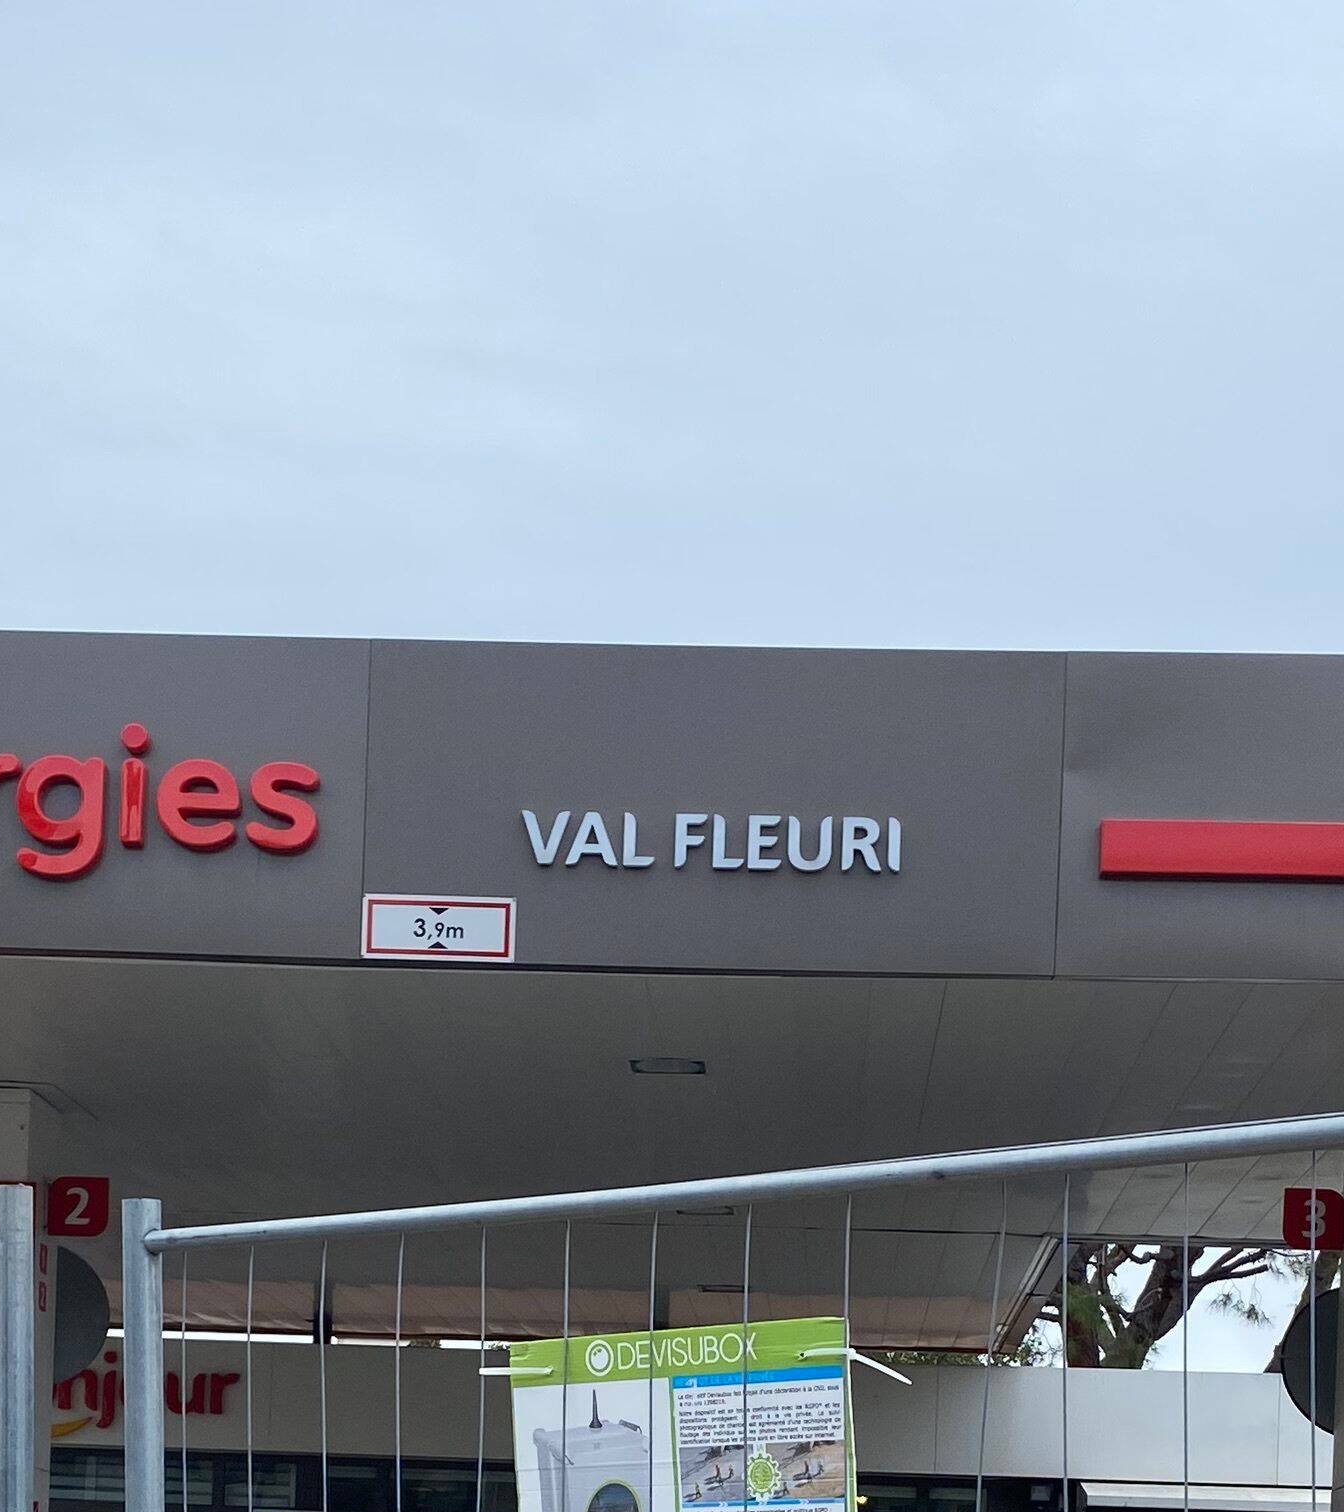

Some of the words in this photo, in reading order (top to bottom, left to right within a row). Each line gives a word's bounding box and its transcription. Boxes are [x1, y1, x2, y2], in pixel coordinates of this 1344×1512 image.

[521, 809, 656, 869] VAL
[673, 812, 902, 873] FLEURI
[413, 917, 464, 941] 3,9m
[64, 1186, 91, 1226] 2
[1300, 1199, 1327, 1239] 3
[616, 1331, 758, 1371] DEVISUBOX
